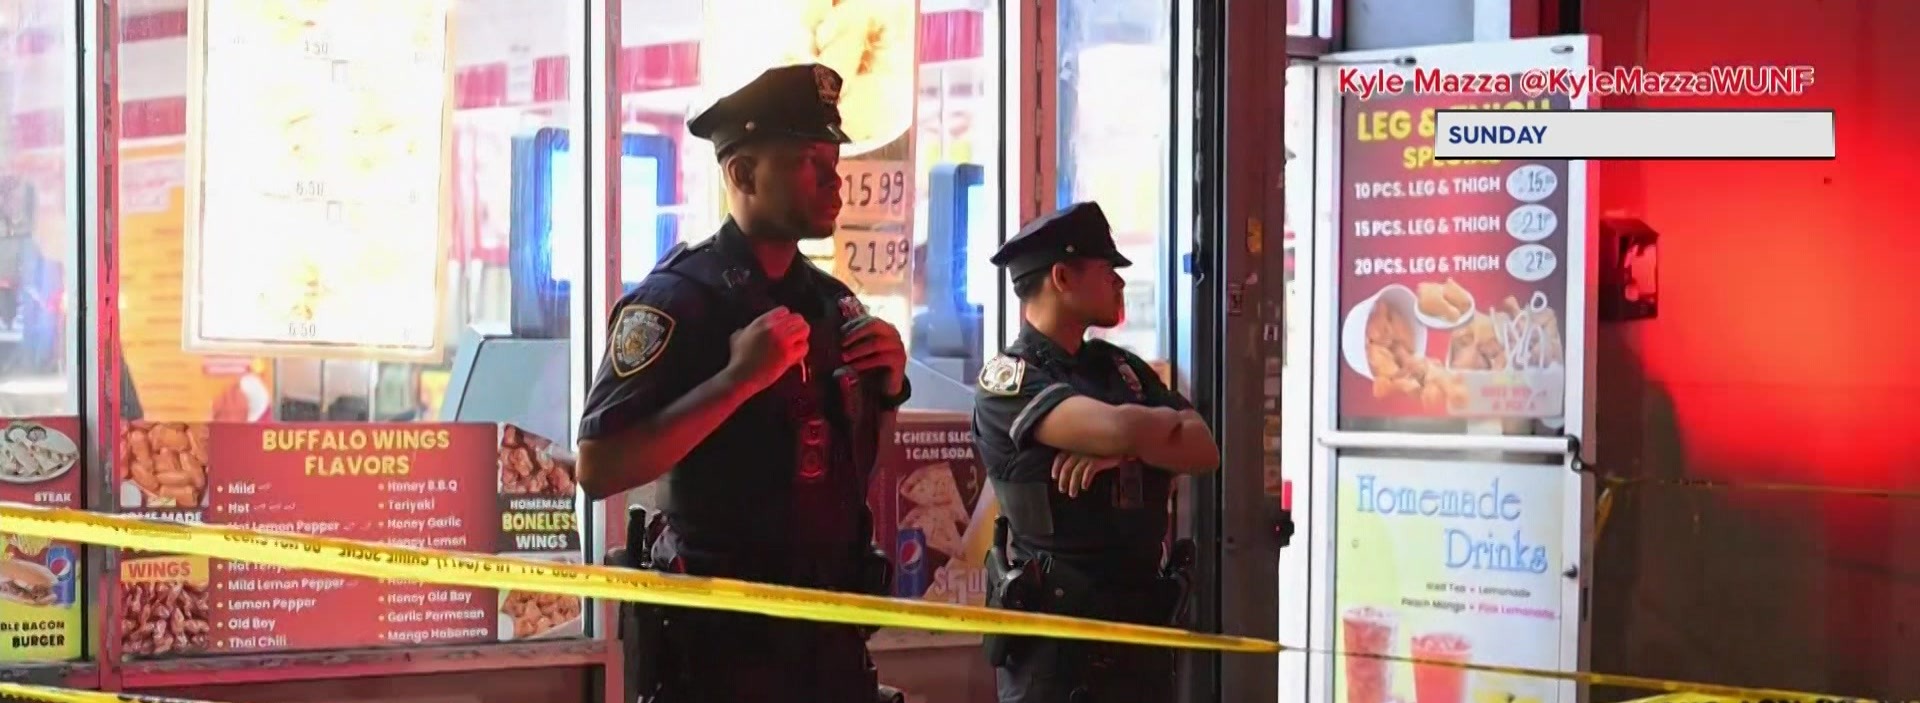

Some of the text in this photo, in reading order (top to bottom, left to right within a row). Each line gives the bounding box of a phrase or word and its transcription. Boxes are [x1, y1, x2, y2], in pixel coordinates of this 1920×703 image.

[1358, 111, 1411, 141] LEG
[1354, 182, 1371, 199] 10
[1372, 181, 1406, 198] PCS.
[1408, 179, 1435, 197] LEG
[1437, 178, 1449, 195] &
[1452, 176, 1501, 194] THIGH
[1354, 220, 1370, 237] 15
[1372, 219, 1406, 236] PCS.
[1408, 218, 1435, 235] LEG
[1437, 217, 1449, 234] &
[1452, 214, 1501, 232] THIGH
[845, 239, 909, 273] 21.99
[1354, 258, 1372, 275] 20
[1374, 257, 1407, 274] PCS.
[1409, 256, 1436, 273] LEG
[1437, 255, 1449, 272] &
[1452, 254, 1500, 272] THIGH
[262, 428, 450, 450] BUFFALO WINGS
[902, 430, 946, 444] CHEESE
[905, 447, 974, 460] 1 CAN SODA
[304, 454, 410, 476] FLAVORS
[228, 482, 255, 494] Mild
[388, 481, 425, 494] Honey
[34, 491, 71, 503] STEAK
[510, 498, 572, 510] HOMEMADE
[1357, 474, 1521, 521] Homemade
[228, 502, 249, 514] Hot
[389, 497, 435, 514] Teriyaki
[296, 520, 340, 534] Pepper
[387, 515, 462, 532] Honey Garlic
[502, 511, 577, 532] BONELESS
[427, 534, 466, 546] Lemon
[515, 533, 568, 549] WINGS
[1444, 527, 1549, 574] Drinks
[128, 561, 191, 578] WINGS
[228, 577, 345, 592] Mild Lemon Pepper
[228, 598, 317, 613] Lemon Pepper
[387, 593, 425, 606] Honey
[427, 590, 448, 602] Old
[387, 608, 485, 622] Garlic Parmesan
[22, 620, 65, 632] BACON
[228, 617, 250, 630] Old
[12, 634, 65, 648] BURGER
[229, 634, 287, 648] Thai Chili
[387, 627, 489, 644] Mango Habanero
